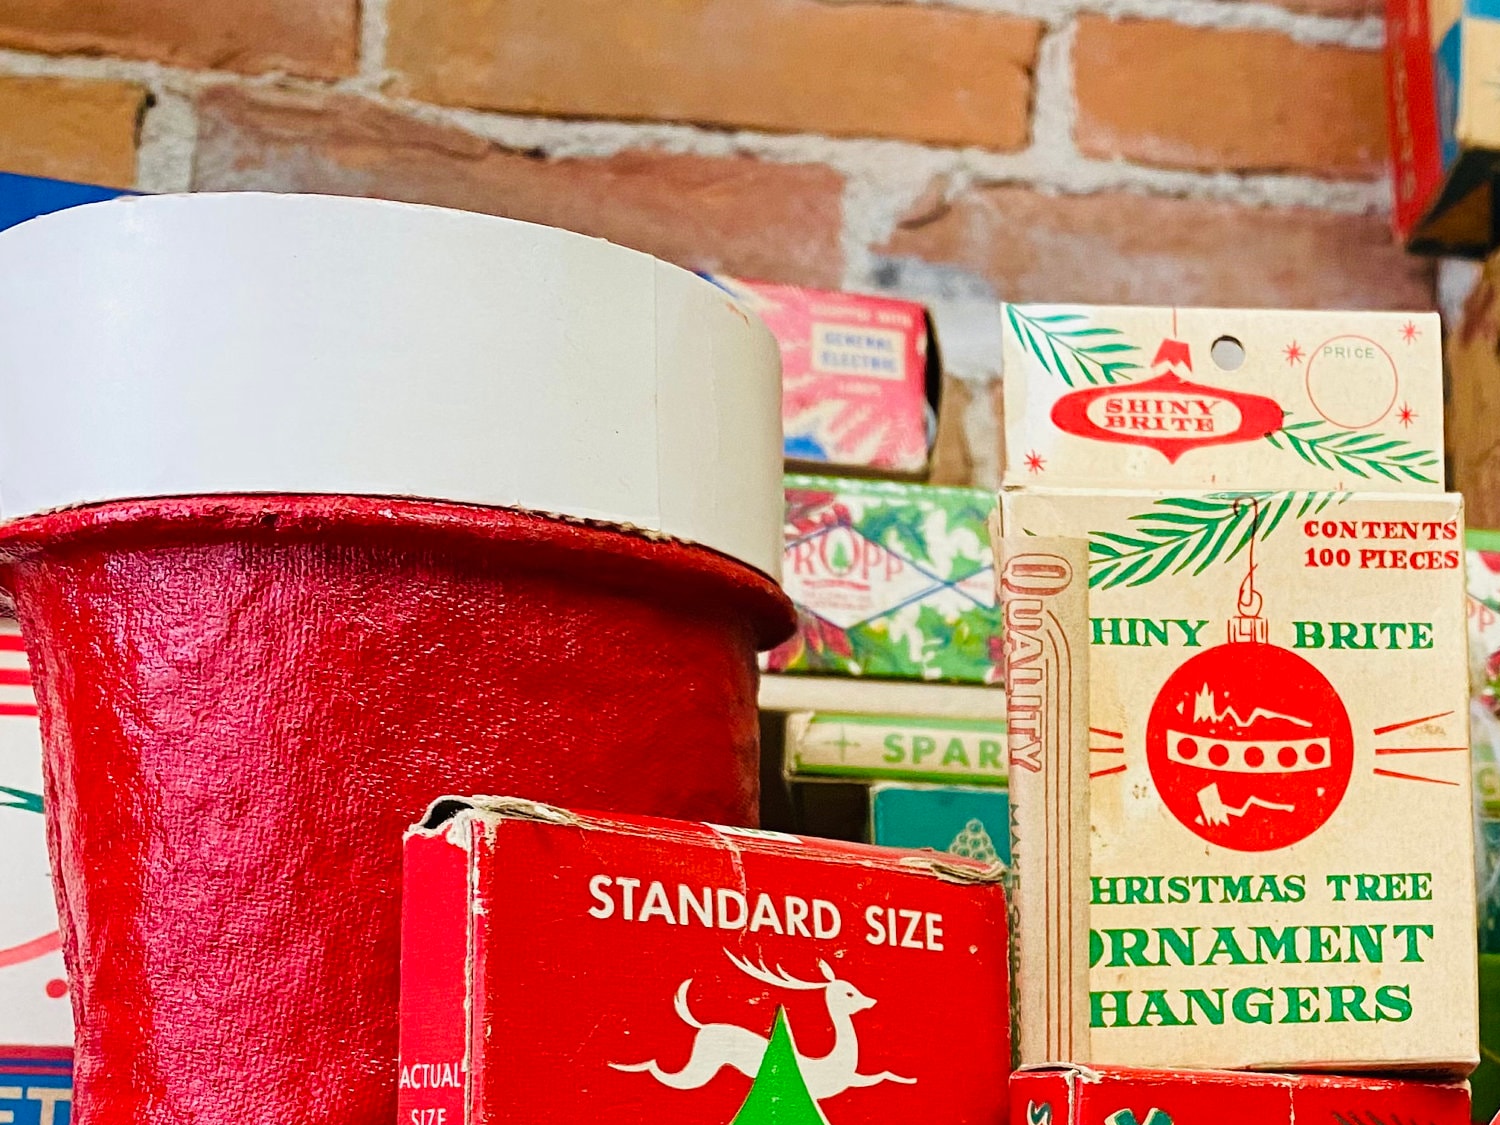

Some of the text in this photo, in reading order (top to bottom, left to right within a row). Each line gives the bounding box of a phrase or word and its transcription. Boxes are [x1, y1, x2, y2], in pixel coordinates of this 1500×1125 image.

[1323, 345, 1375, 360] PRICE
[1105, 398, 1221, 416] SHINY
[1104, 415, 1215, 433] BRITE
[1303, 519, 1458, 542] CONTENTS
[786, 527, 905, 582] ROPP
[1304, 548, 1460, 571] 100 PIECES
[1292, 621, 1435, 649] BRITE
[1001, 553, 1073, 773] QUALITY
[1327, 872, 1433, 902] TREE
[587, 874, 945, 952] STANDARD SIZE
[1090, 984, 1414, 1028] HANGERS
[400, 1062, 462, 1090] ACTUAL
